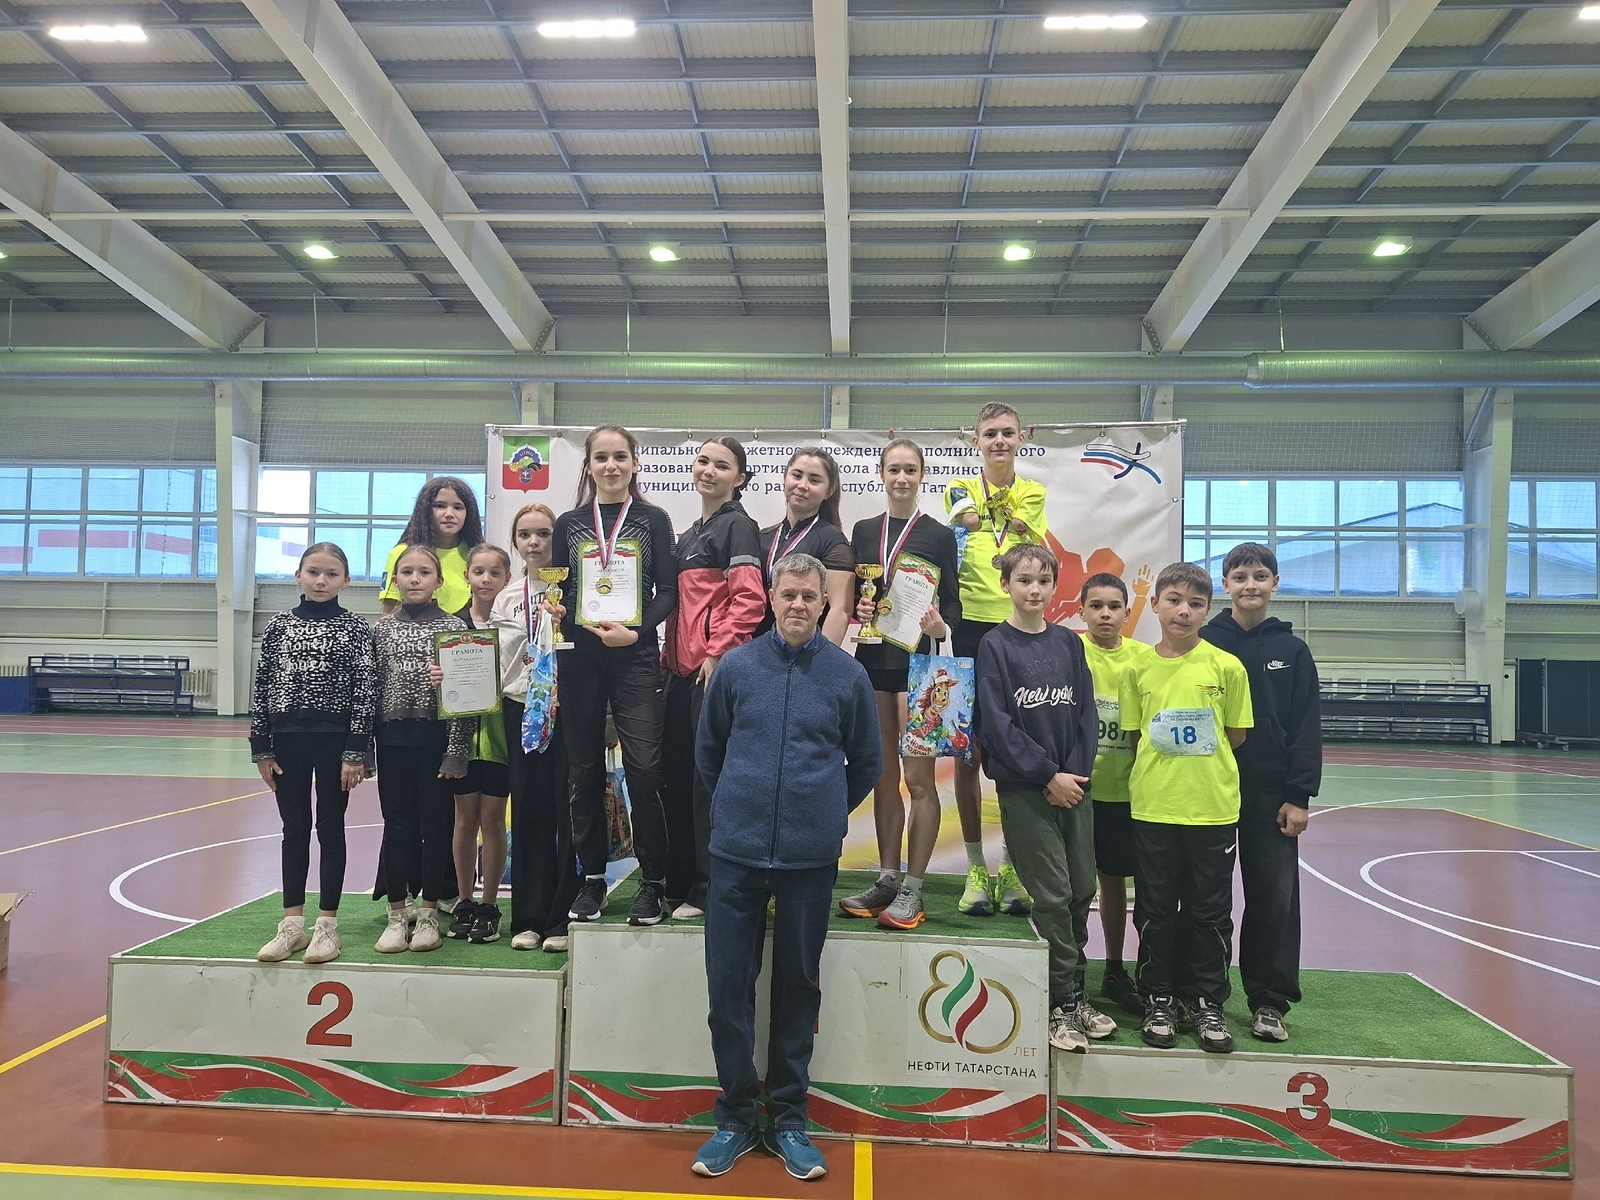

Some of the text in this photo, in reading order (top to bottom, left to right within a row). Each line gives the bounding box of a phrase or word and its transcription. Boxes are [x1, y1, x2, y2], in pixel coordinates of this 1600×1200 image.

[451, 648, 483, 656] ГРАМОТА
[1170, 725, 1197, 745] 18
[306, 981, 353, 1047] 2
[1013, 1047, 1037, 1057] ЛЕТ
[907, 1061, 1037, 1078] НЕФТИ ТАТАРСТАНА
[1286, 1071, 1331, 1131] 3
